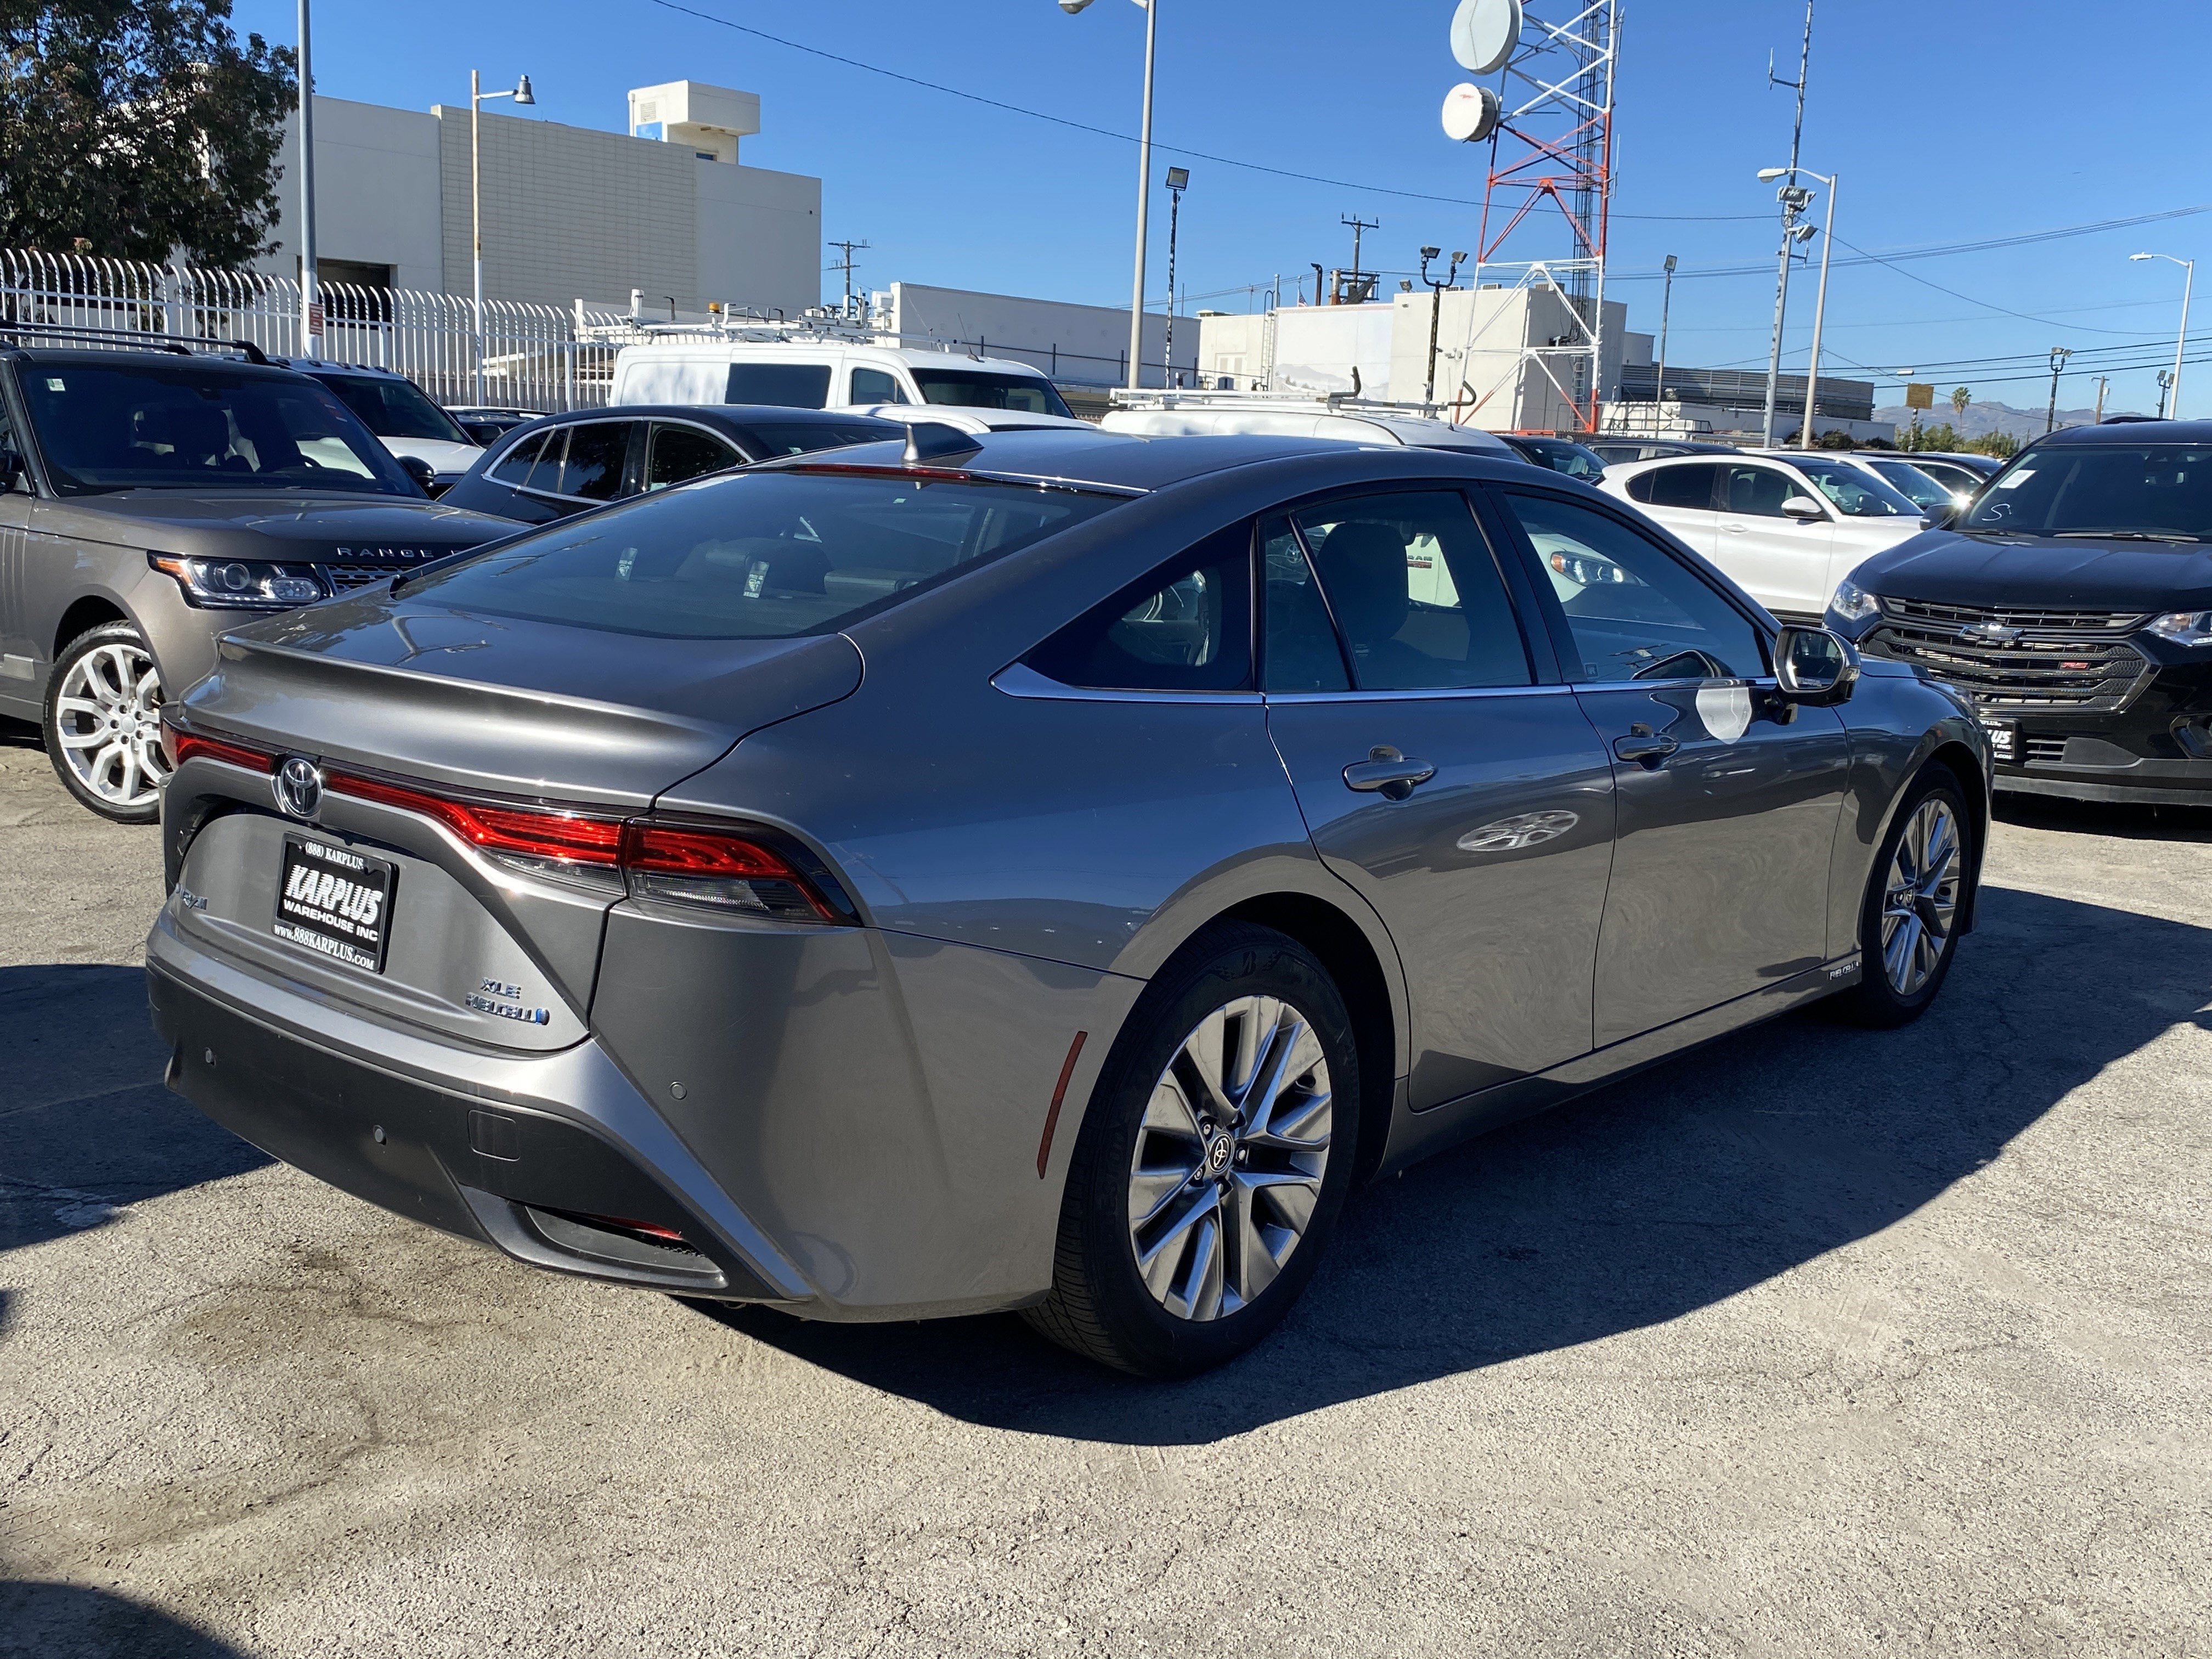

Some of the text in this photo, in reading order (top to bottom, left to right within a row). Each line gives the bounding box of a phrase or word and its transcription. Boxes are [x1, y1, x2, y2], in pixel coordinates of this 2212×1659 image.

[336, 547, 434, 558] RANGE
[305, 841, 364, 870] (888) KARPLUS
[284, 865, 383, 925] KARPLUS
[283, 899, 379, 941] WAREHOUSE INC
[480, 977, 521, 1000] XLE
